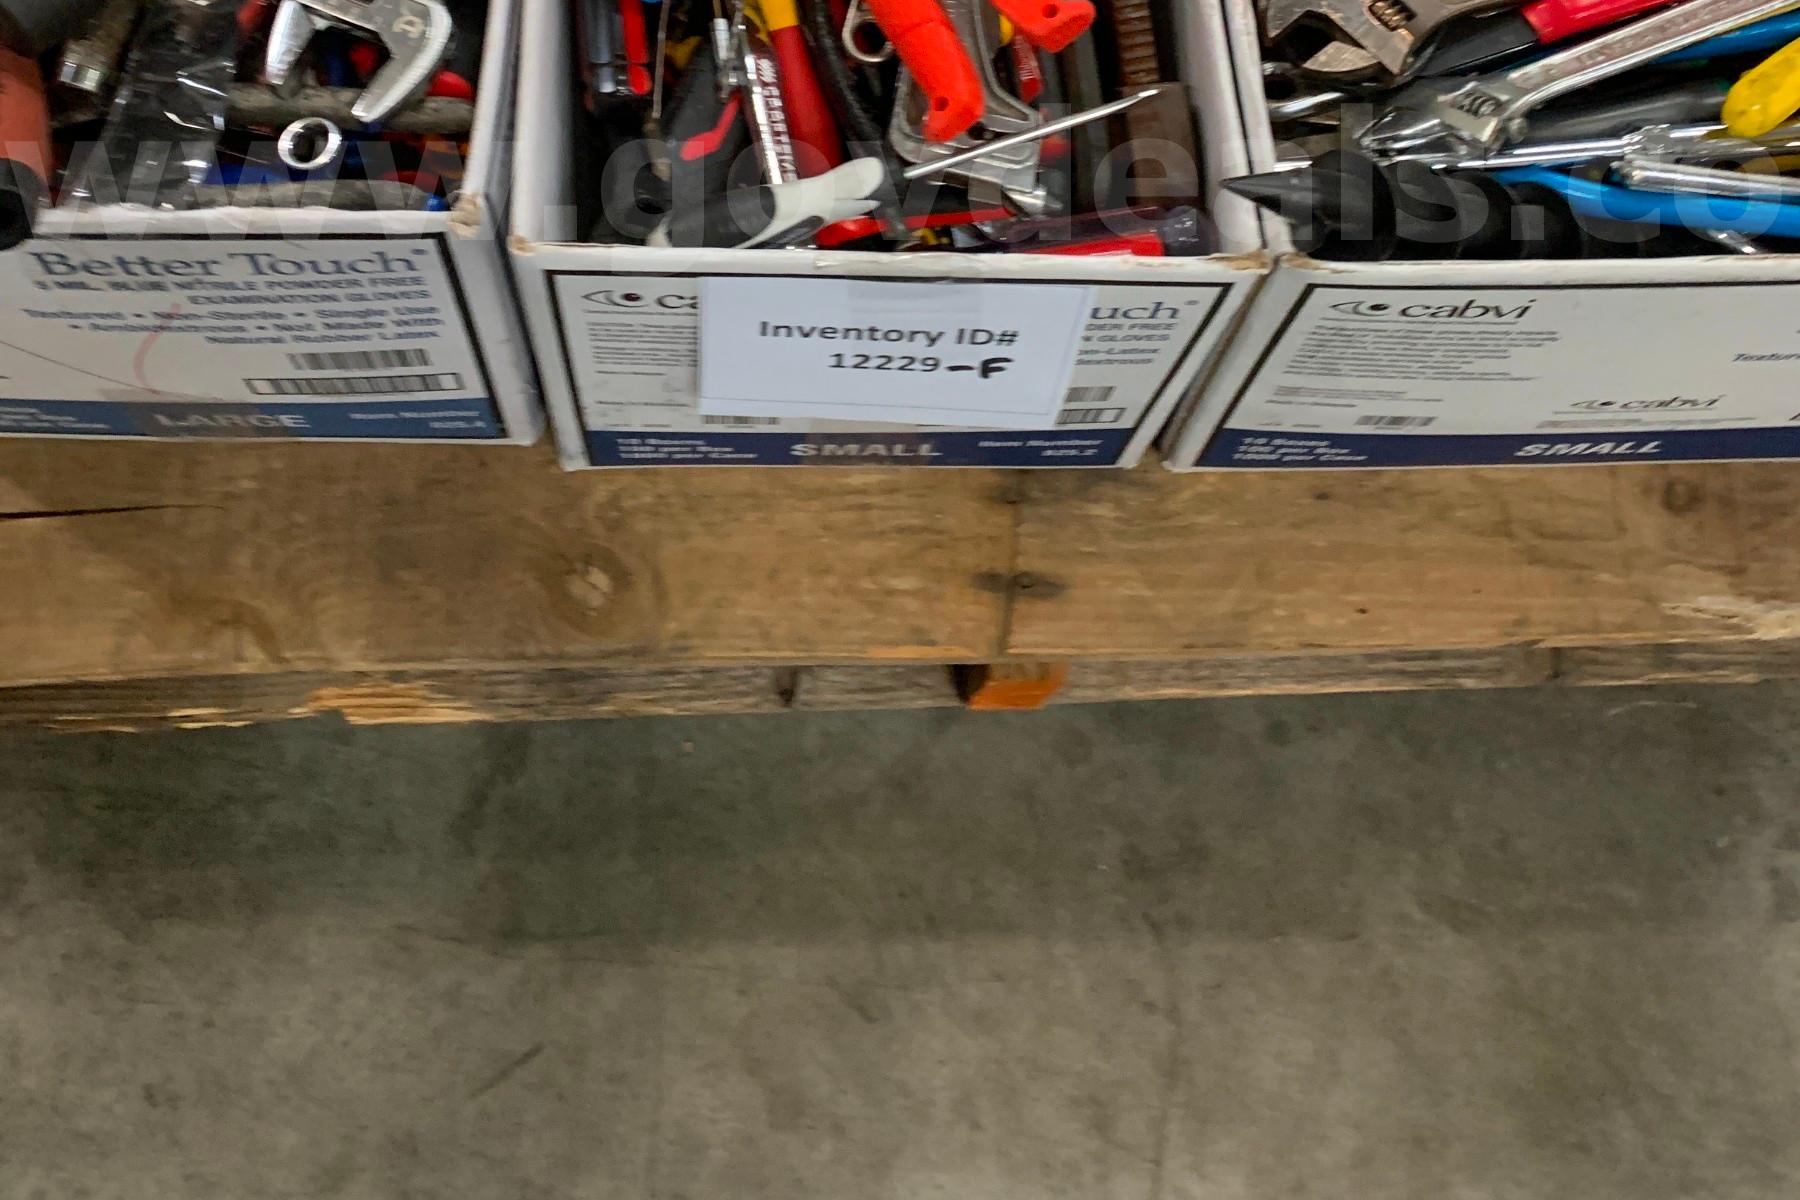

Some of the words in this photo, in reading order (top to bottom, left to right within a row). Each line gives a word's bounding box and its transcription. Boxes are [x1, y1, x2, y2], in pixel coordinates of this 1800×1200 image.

[26, 252, 222, 277] Better
[367, 276, 428, 287] FREE
[343, 289, 433, 302] GLOVES
[1400, 298, 1538, 319] cabvi
[758, 319, 947, 347] Inventory
[954, 327, 1020, 346] ID#
[152, 413, 313, 429] LARGE
[789, 442, 944, 457] SMALL
[1514, 440, 1663, 457] SMALL
